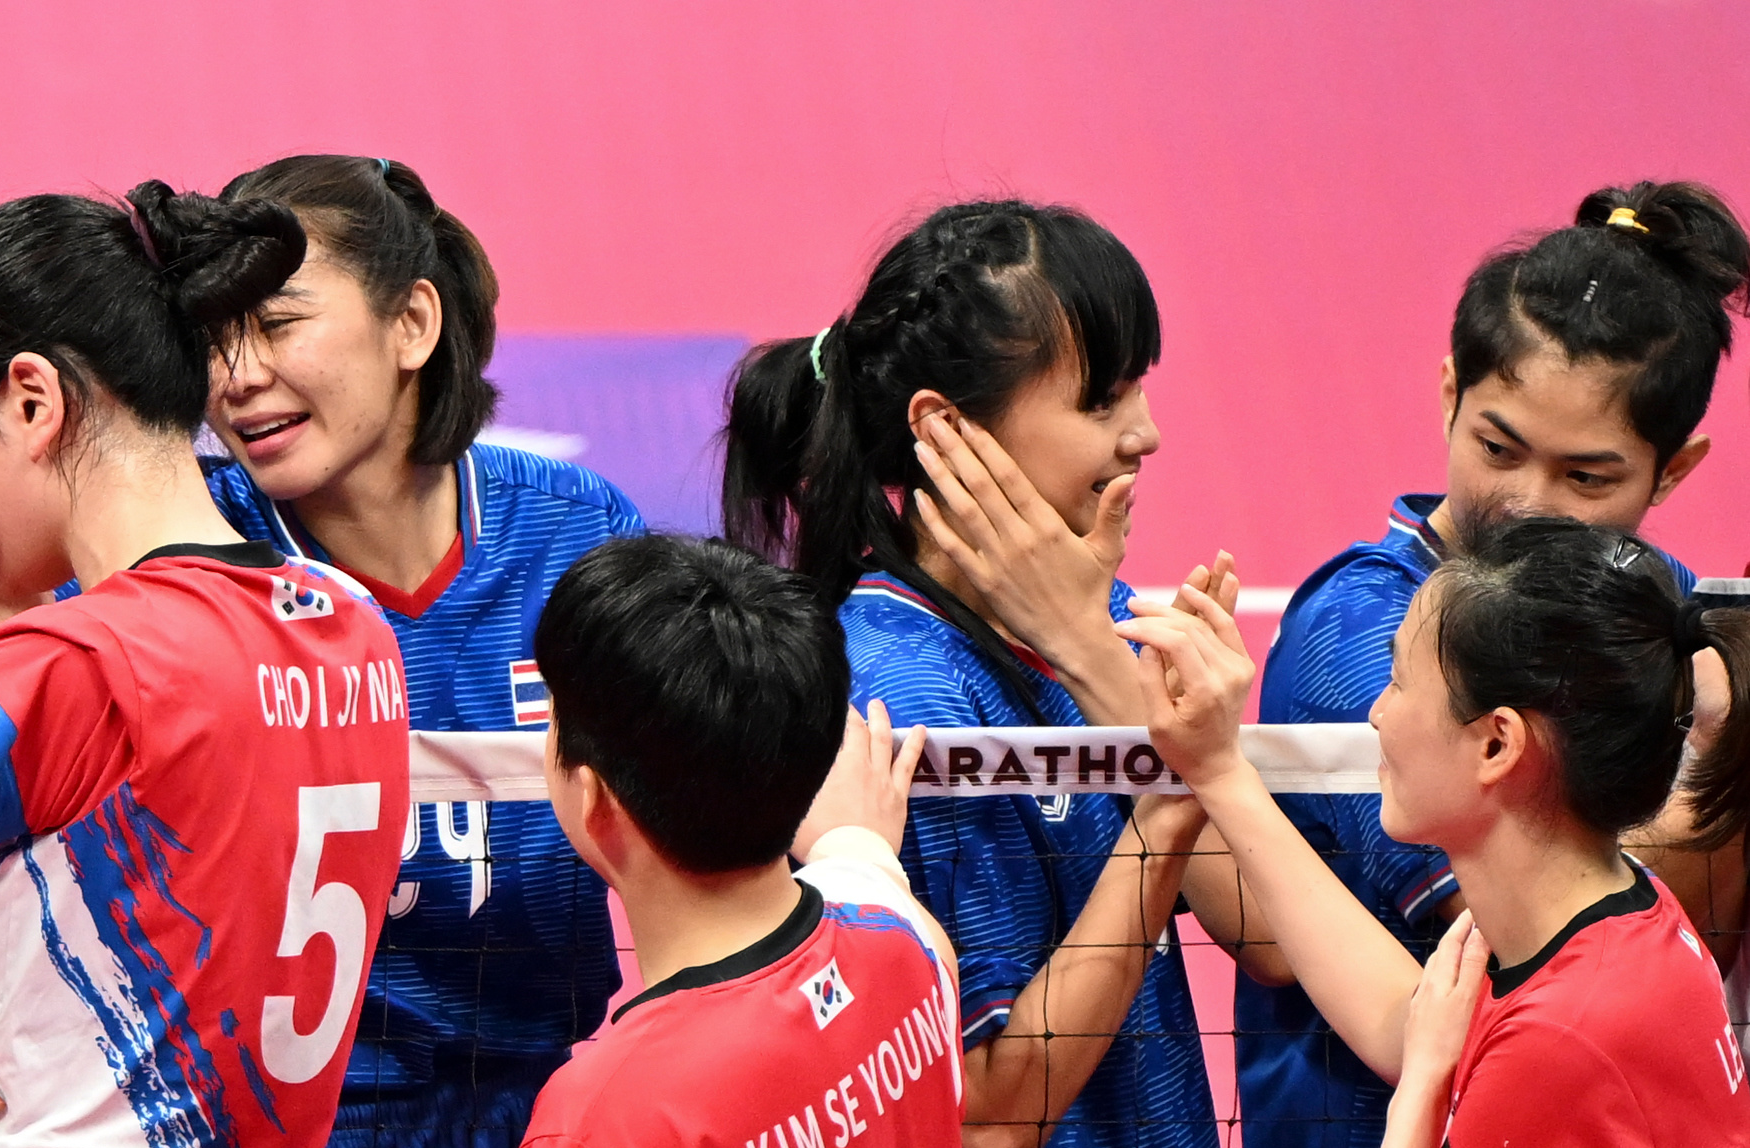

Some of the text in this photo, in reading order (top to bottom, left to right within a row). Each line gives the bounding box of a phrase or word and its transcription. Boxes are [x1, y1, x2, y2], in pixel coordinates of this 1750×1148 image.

[337, 665, 361, 727] JI
[366, 658, 405, 723] NA
[911, 743, 1184, 787] ARATHO
[261, 781, 381, 1085] 5
[825, 1073, 867, 1148] SE
